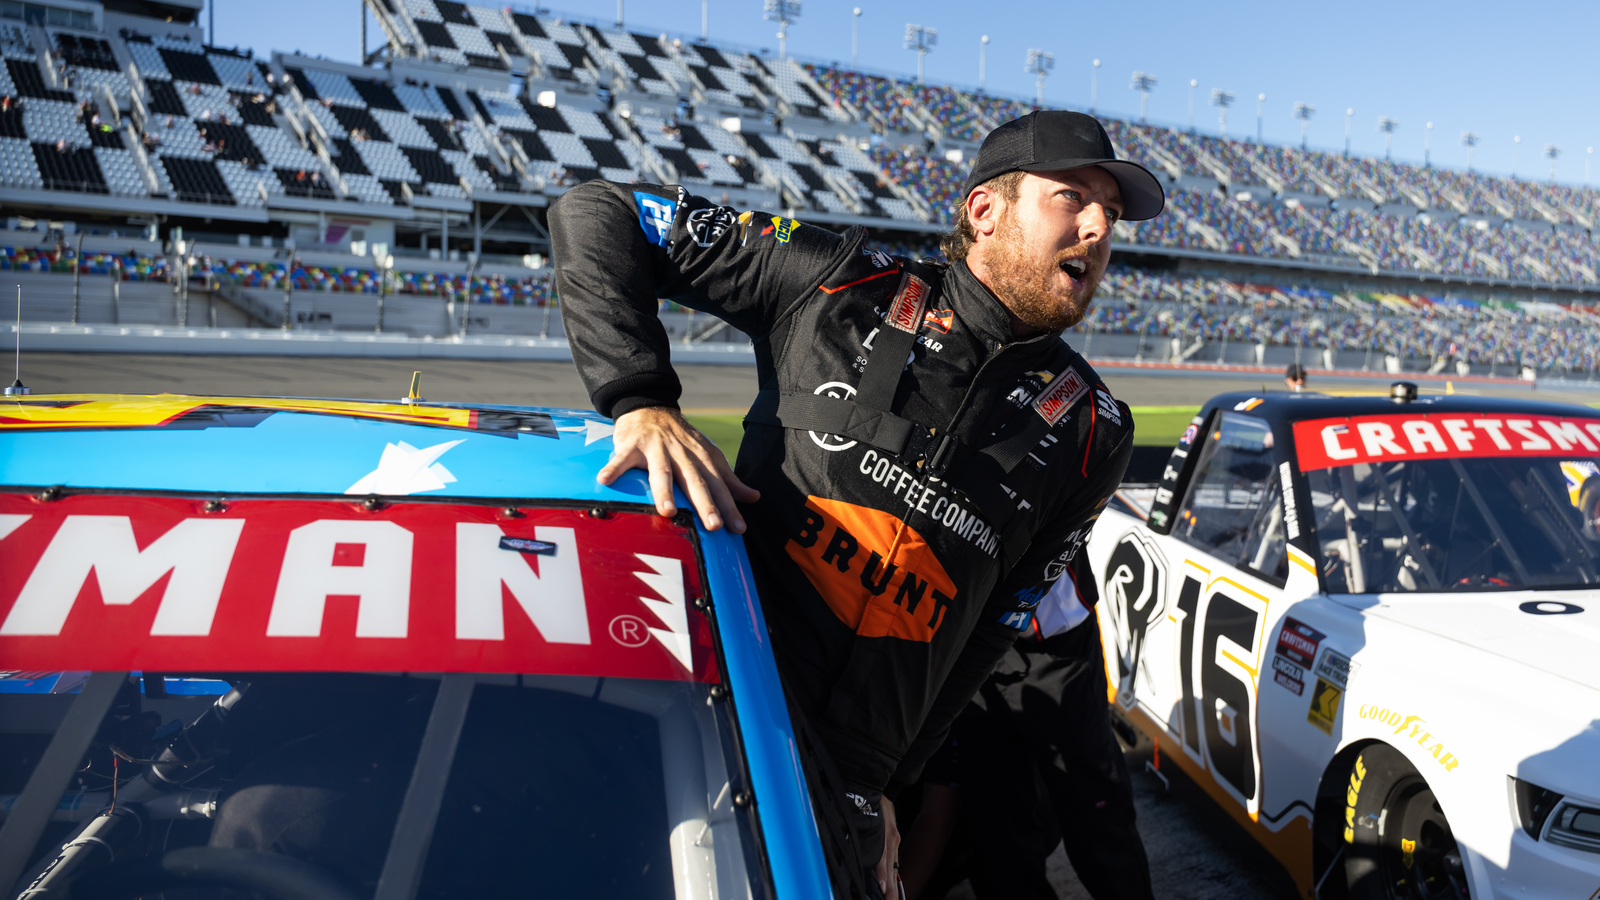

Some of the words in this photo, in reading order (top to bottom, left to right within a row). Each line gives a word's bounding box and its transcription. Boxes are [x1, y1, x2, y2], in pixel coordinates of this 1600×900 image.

[897, 280, 922, 326] SIMPSON
[1042, 375, 1079, 416] SIMPSON
[1097, 407, 1122, 427] SIMPSON
[860, 449, 937, 514] COFFEE
[0, 514, 591, 645] MAN
[800, 502, 948, 630] BRUNT
[1280, 629, 1316, 656] CRAFTSMAN
[1331, 656, 1353, 675] NASCAR
[1176, 574, 1259, 801] 16
[1274, 657, 1302, 681] LINCOLN
[1319, 661, 1334, 677] RACE
[1333, 668, 1349, 686] TRUCK
[1359, 703, 1459, 773] GOODYEAR
[1344, 755, 1367, 844] EAGLE
